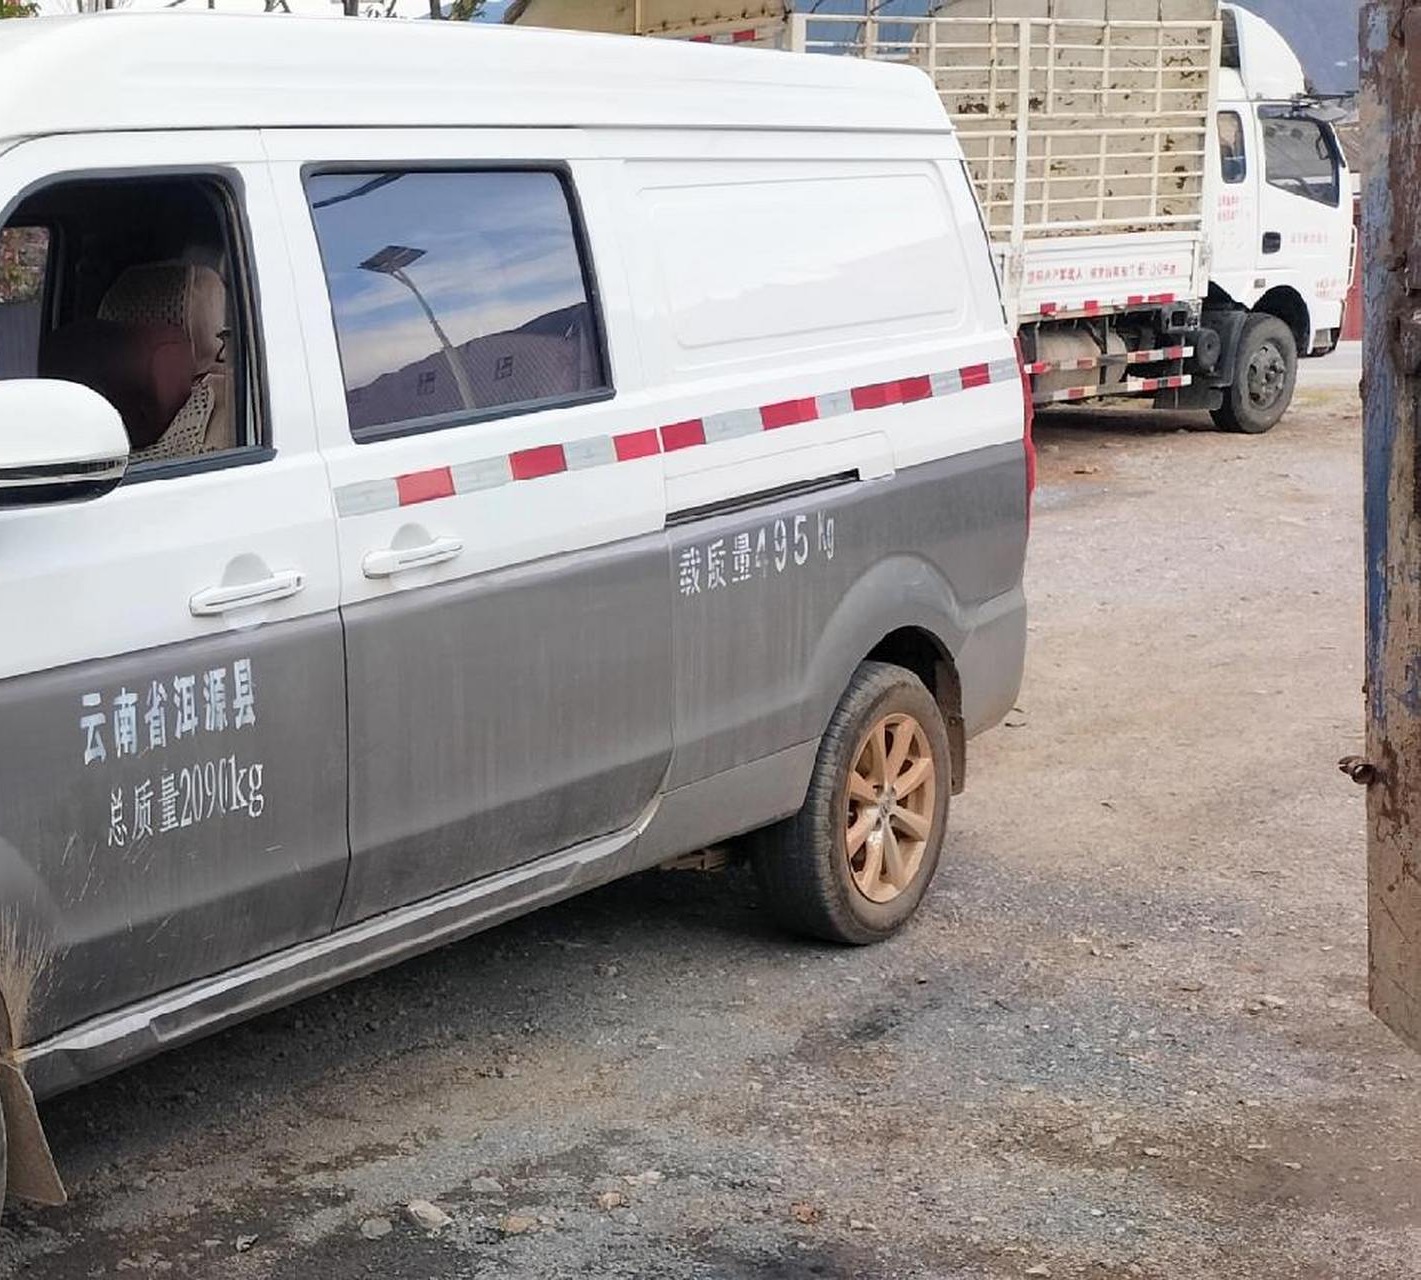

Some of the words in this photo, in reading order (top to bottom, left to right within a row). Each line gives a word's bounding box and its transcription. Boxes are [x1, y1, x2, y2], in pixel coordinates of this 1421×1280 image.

[80, 658, 256, 765] 云南省洱源县
